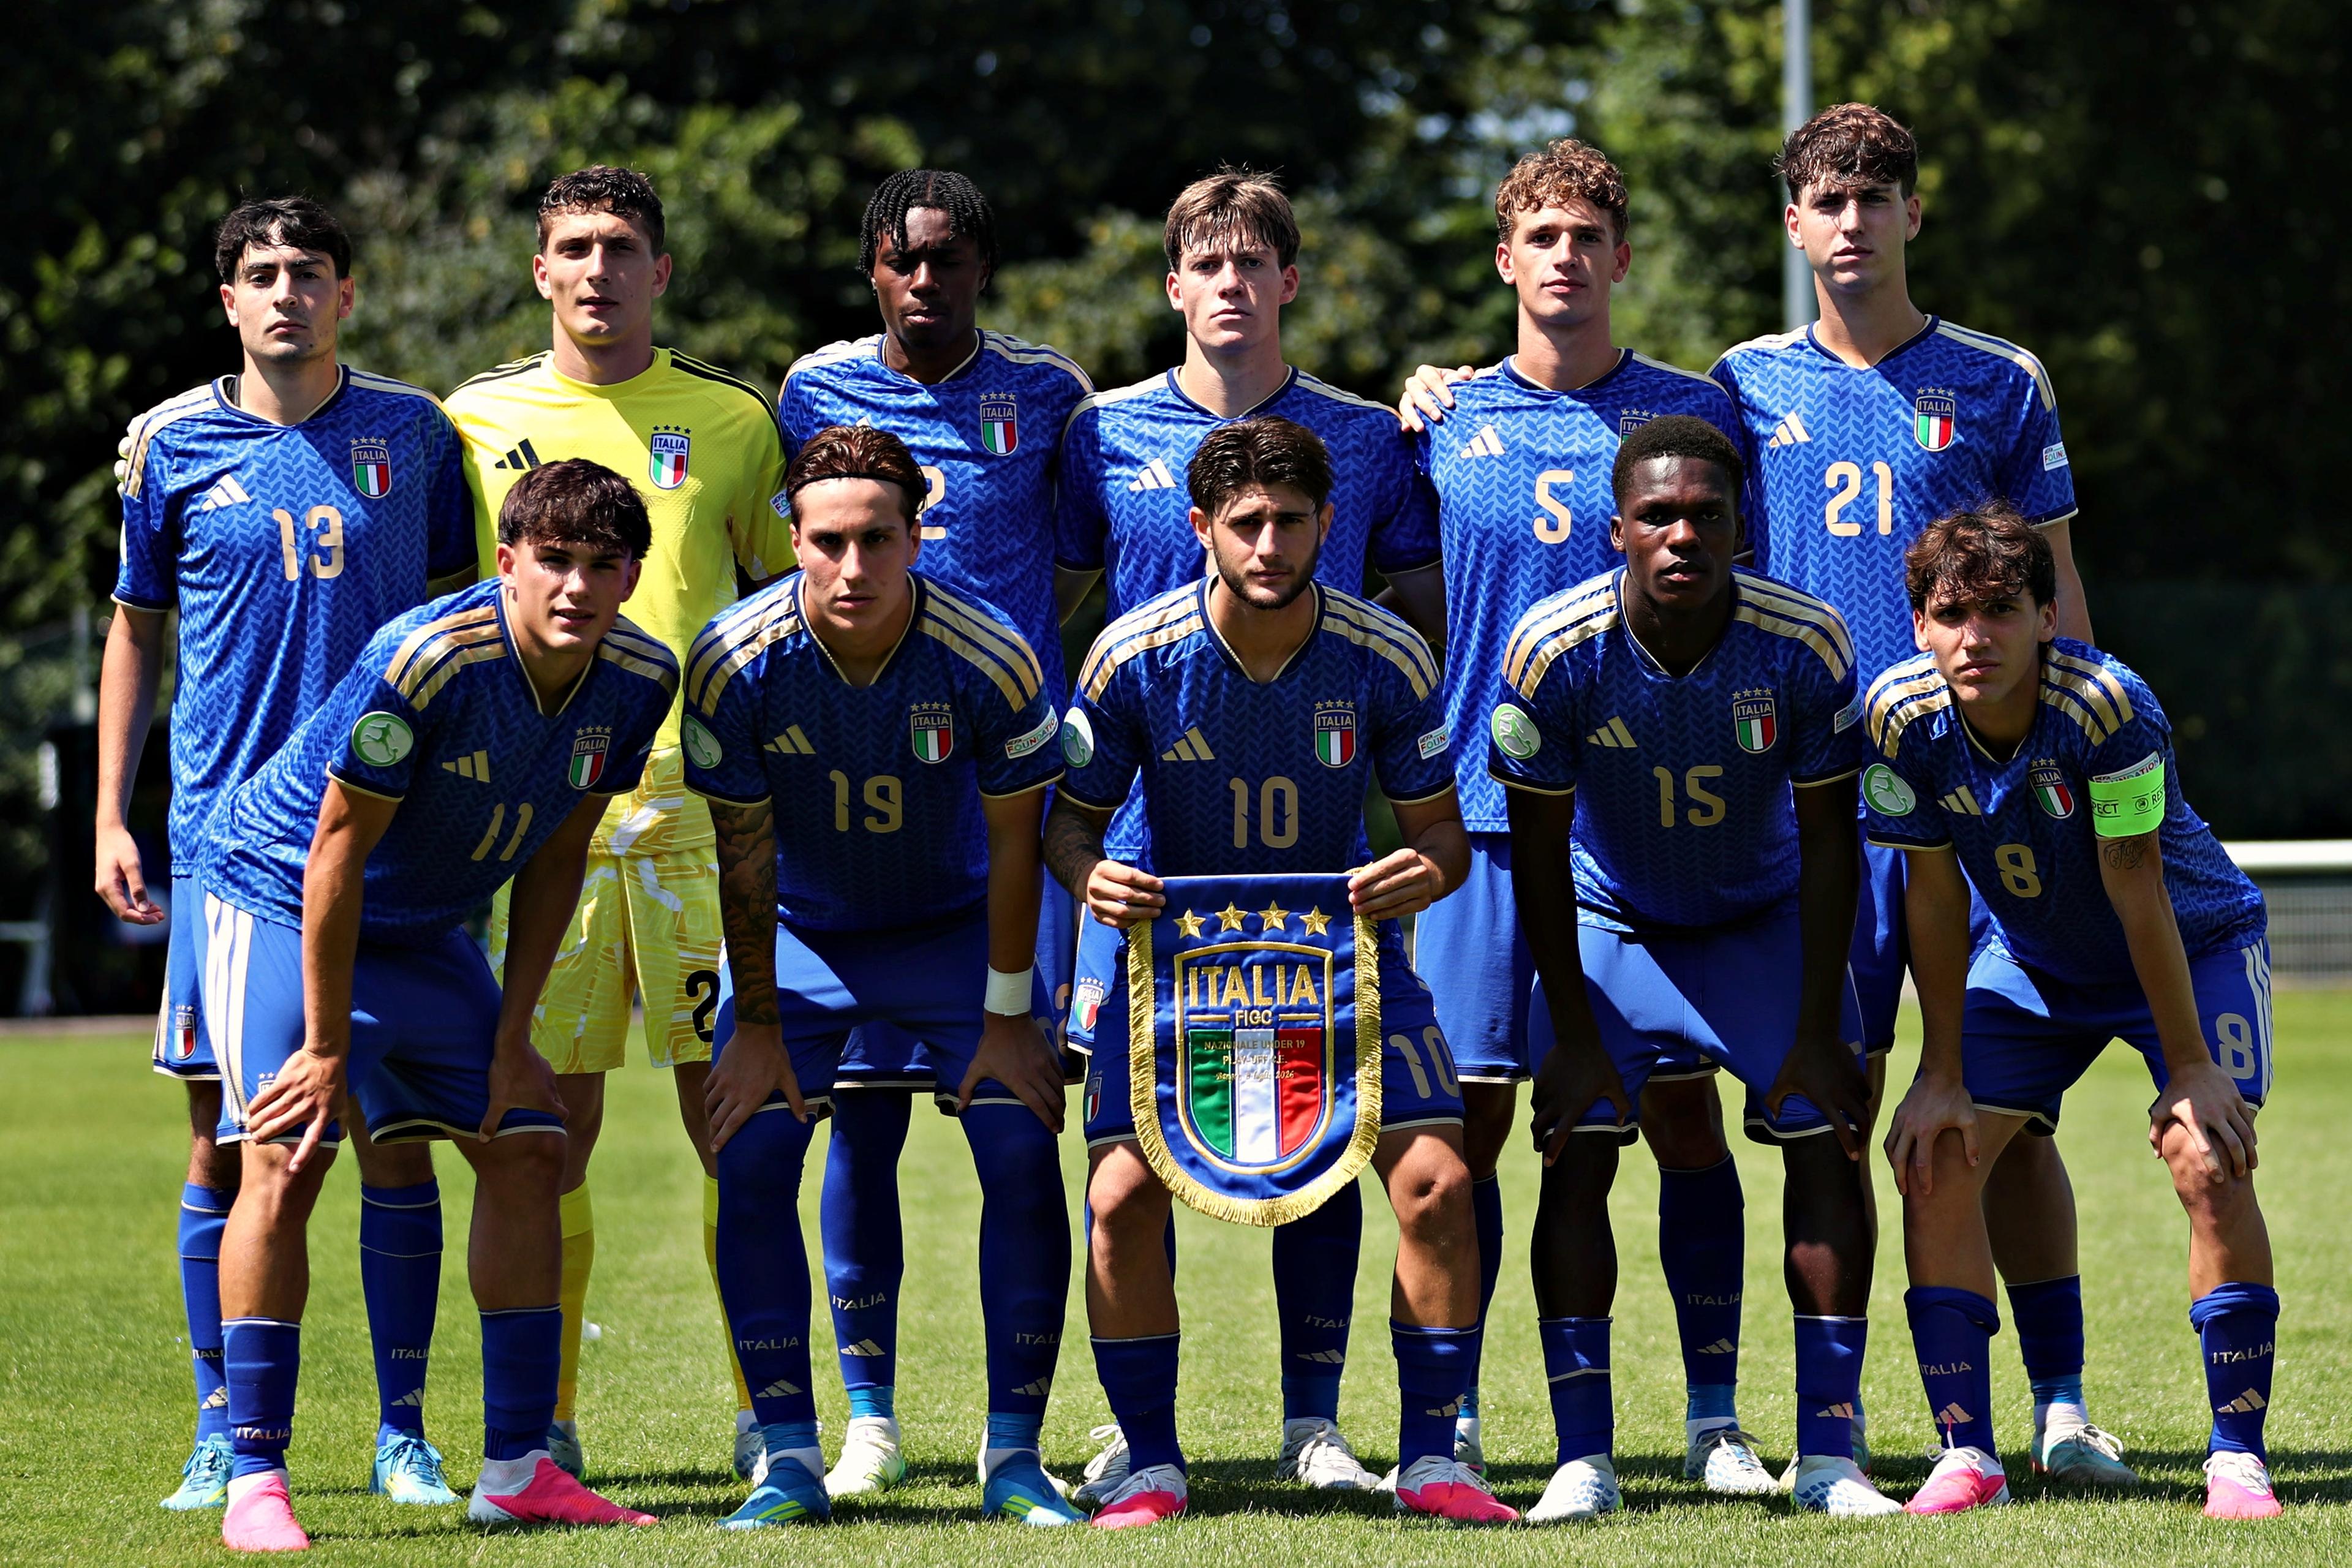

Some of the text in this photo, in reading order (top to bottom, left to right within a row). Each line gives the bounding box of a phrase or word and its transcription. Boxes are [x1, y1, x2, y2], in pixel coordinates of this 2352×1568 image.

[982, 407, 1013, 418] ITALIA
[1918, 401, 1951, 412] ITALIA
[654, 437, 686, 451] ITALIA
[354, 450, 386, 461] ITALIA
[1825, 461, 1893, 537] 21
[1533, 470, 1574, 544] 5
[273, 505, 345, 581] 13
[1737, 703, 1772, 716] ITALIA
[914, 716, 949, 726] ITALIA
[1317, 715, 1352, 726] ITALIA
[575, 739, 605, 752] ITALIA
[2030, 771, 2062, 784] ITALIA
[829, 769, 903, 834] 19
[1654, 765, 1726, 828] 15
[2091, 787, 2164, 814] PECT RES
[1229, 775, 1298, 849] 10
[470, 802, 533, 862] 11
[1994, 843, 2043, 899] 8
[1188, 964, 1319, 1008] ITALIA
[1234, 1009, 1273, 1027] FIGC
[1204, 1039, 1305, 1050] NAZIONALE UNDER 19
[2216, 1012, 2256, 1080] 8
[1389, 1025, 1461, 1099] 10
[1275, 1070, 1294, 1080] 2026
[832, 1292, 886, 1311] ITALIA
[1687, 1292, 1741, 1306] ITALIA
[1305, 1314, 1352, 1329] ITALI
[739, 1336, 799, 1351] ITALIA
[1016, 1332, 1061, 1345] ITALI
[192, 1348, 223, 1359] ITALI
[2213, 1340, 2274, 1364] ITALIA
[1920, 1361, 1972, 1376] ITALIA
[236, 1427, 290, 1440] ITALIA
